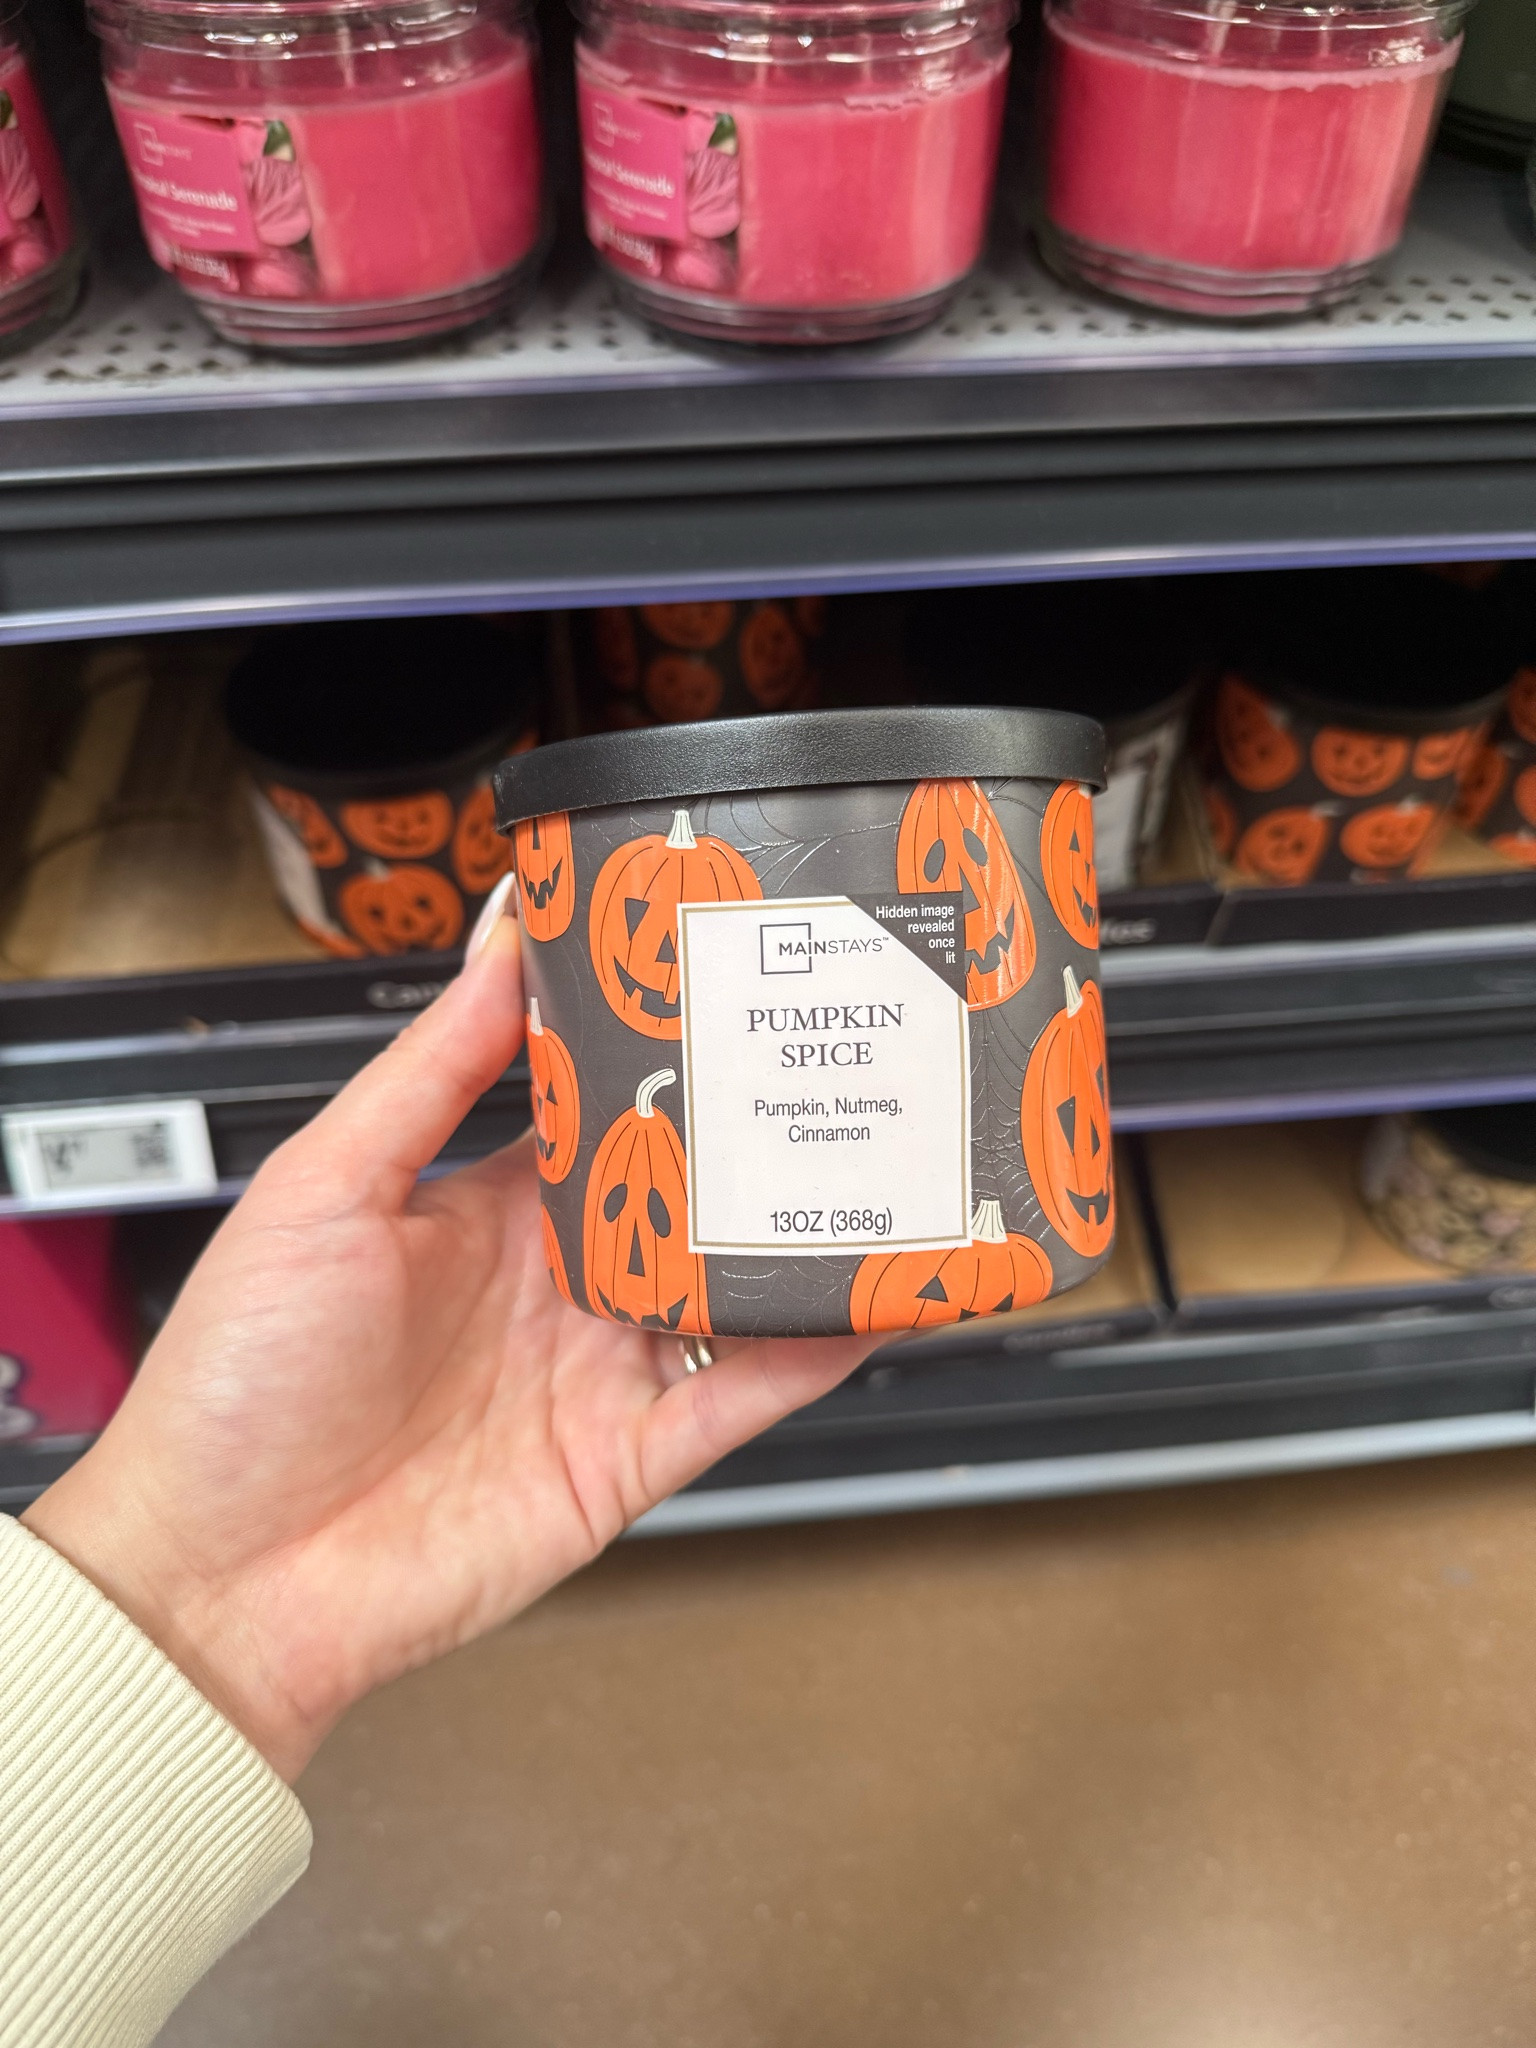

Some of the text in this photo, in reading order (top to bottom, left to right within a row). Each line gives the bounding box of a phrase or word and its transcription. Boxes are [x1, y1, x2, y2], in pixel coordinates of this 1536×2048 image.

[876, 904, 955, 919] Hidden image
[907, 919, 955, 934] revealed
[928, 937, 956, 949] once
[945, 951, 956, 964] lit
[746, 1003, 905, 1033] PUMPKIN
[780, 1042, 874, 1068] SPICE
[754, 1096, 903, 1120] Pumpkin, Nutmeg,
[788, 1124, 871, 1143] Cinnamon
[769, 1207, 893, 1237] 13OZ (368g)
